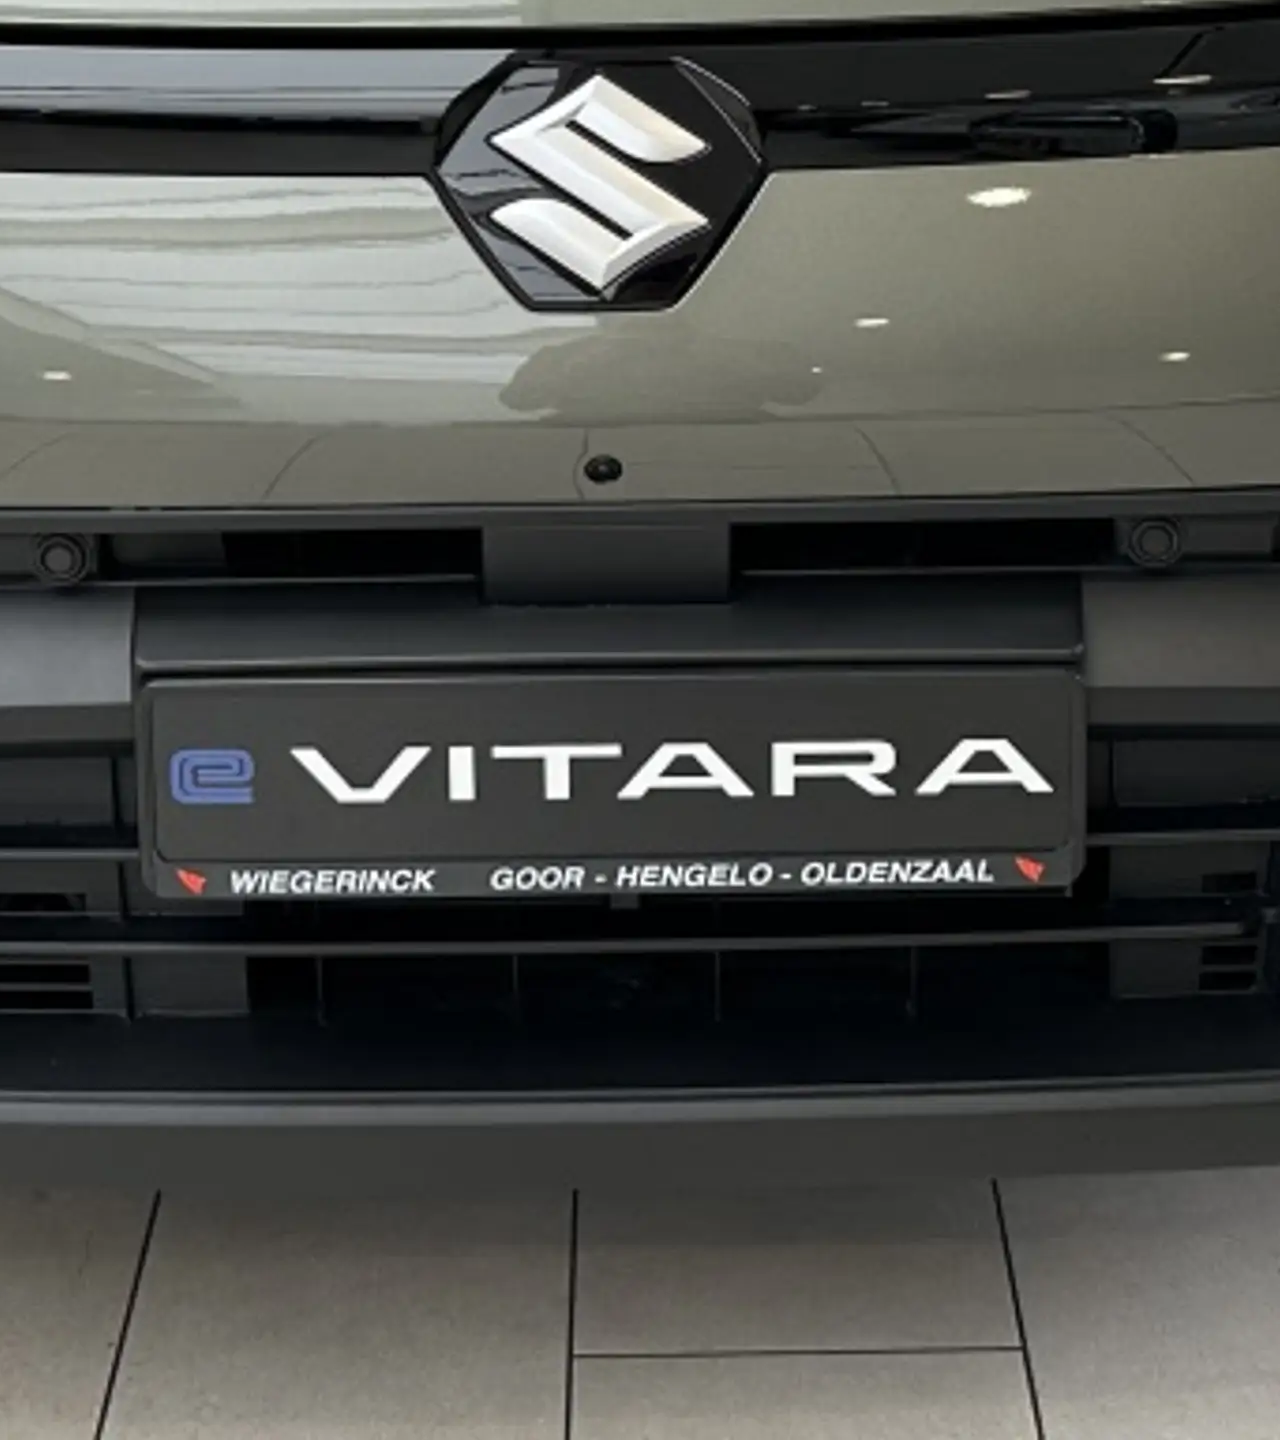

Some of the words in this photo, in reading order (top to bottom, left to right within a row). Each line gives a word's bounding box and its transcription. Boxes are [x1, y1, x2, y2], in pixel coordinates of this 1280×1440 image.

[290, 737, 1055, 804] VITARA
[229, 867, 436, 895] WIEGERINCK
[489, 866, 586, 891] GOOR
[615, 862, 773, 888] HENGELO
[799, 858, 995, 885] OLDENZAAL
